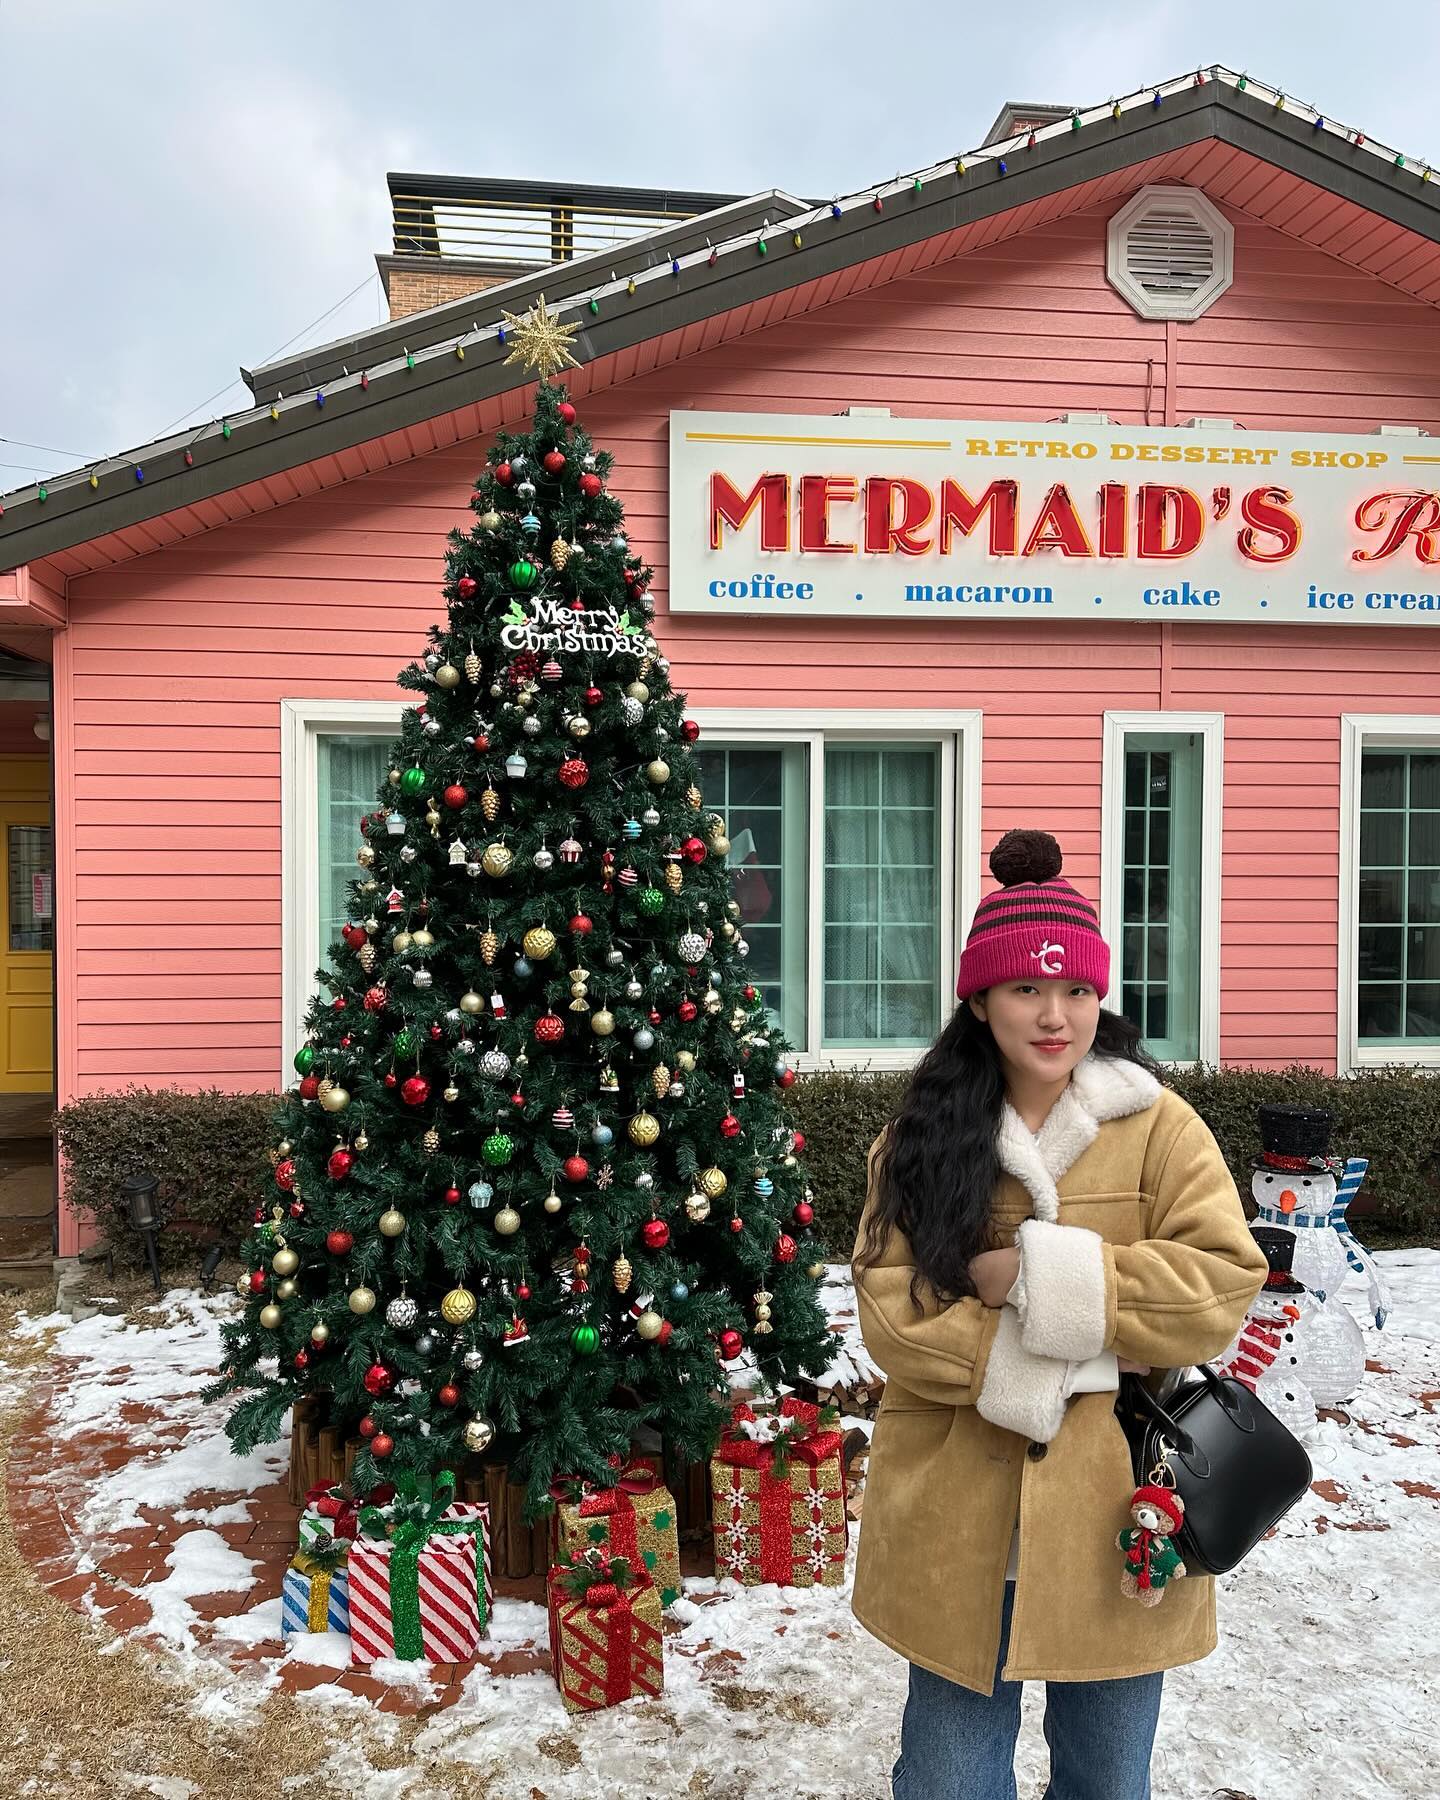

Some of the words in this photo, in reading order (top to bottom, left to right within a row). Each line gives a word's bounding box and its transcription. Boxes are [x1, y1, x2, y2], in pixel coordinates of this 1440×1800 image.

[966, 438, 1098, 460] RETRO
[1110, 443, 1279, 466] DESSERT
[1290, 450, 1389, 469] SHOP
[709, 470, 1302, 563] MERMAID'S
[708, 574, 814, 600] coffee
[905, 583, 1053, 604] macaron
[1143, 581, 1221, 607] cake
[1307, 585, 1354, 610] ice
[1365, 592, 1440, 611] crea
[530, 598, 619, 632] Merry
[500, 623, 648, 657] Christmas
